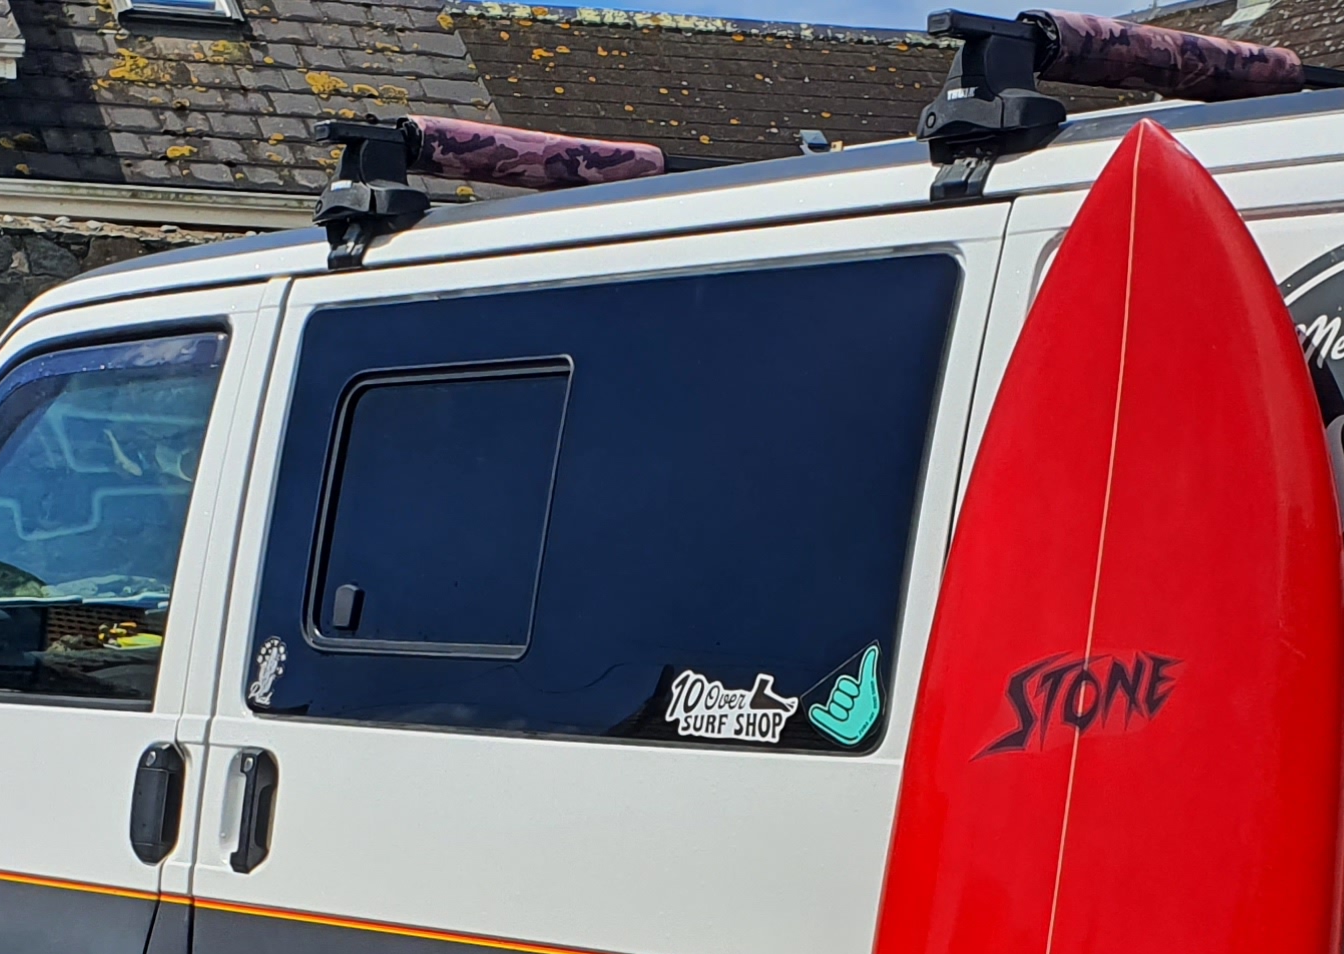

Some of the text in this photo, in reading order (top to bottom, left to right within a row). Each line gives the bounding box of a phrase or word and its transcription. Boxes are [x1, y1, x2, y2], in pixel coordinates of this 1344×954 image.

[668, 674, 747, 717] 10 Over
[968, 650, 1185, 763] STONE
[681, 713, 783, 739] SURF SHOP
